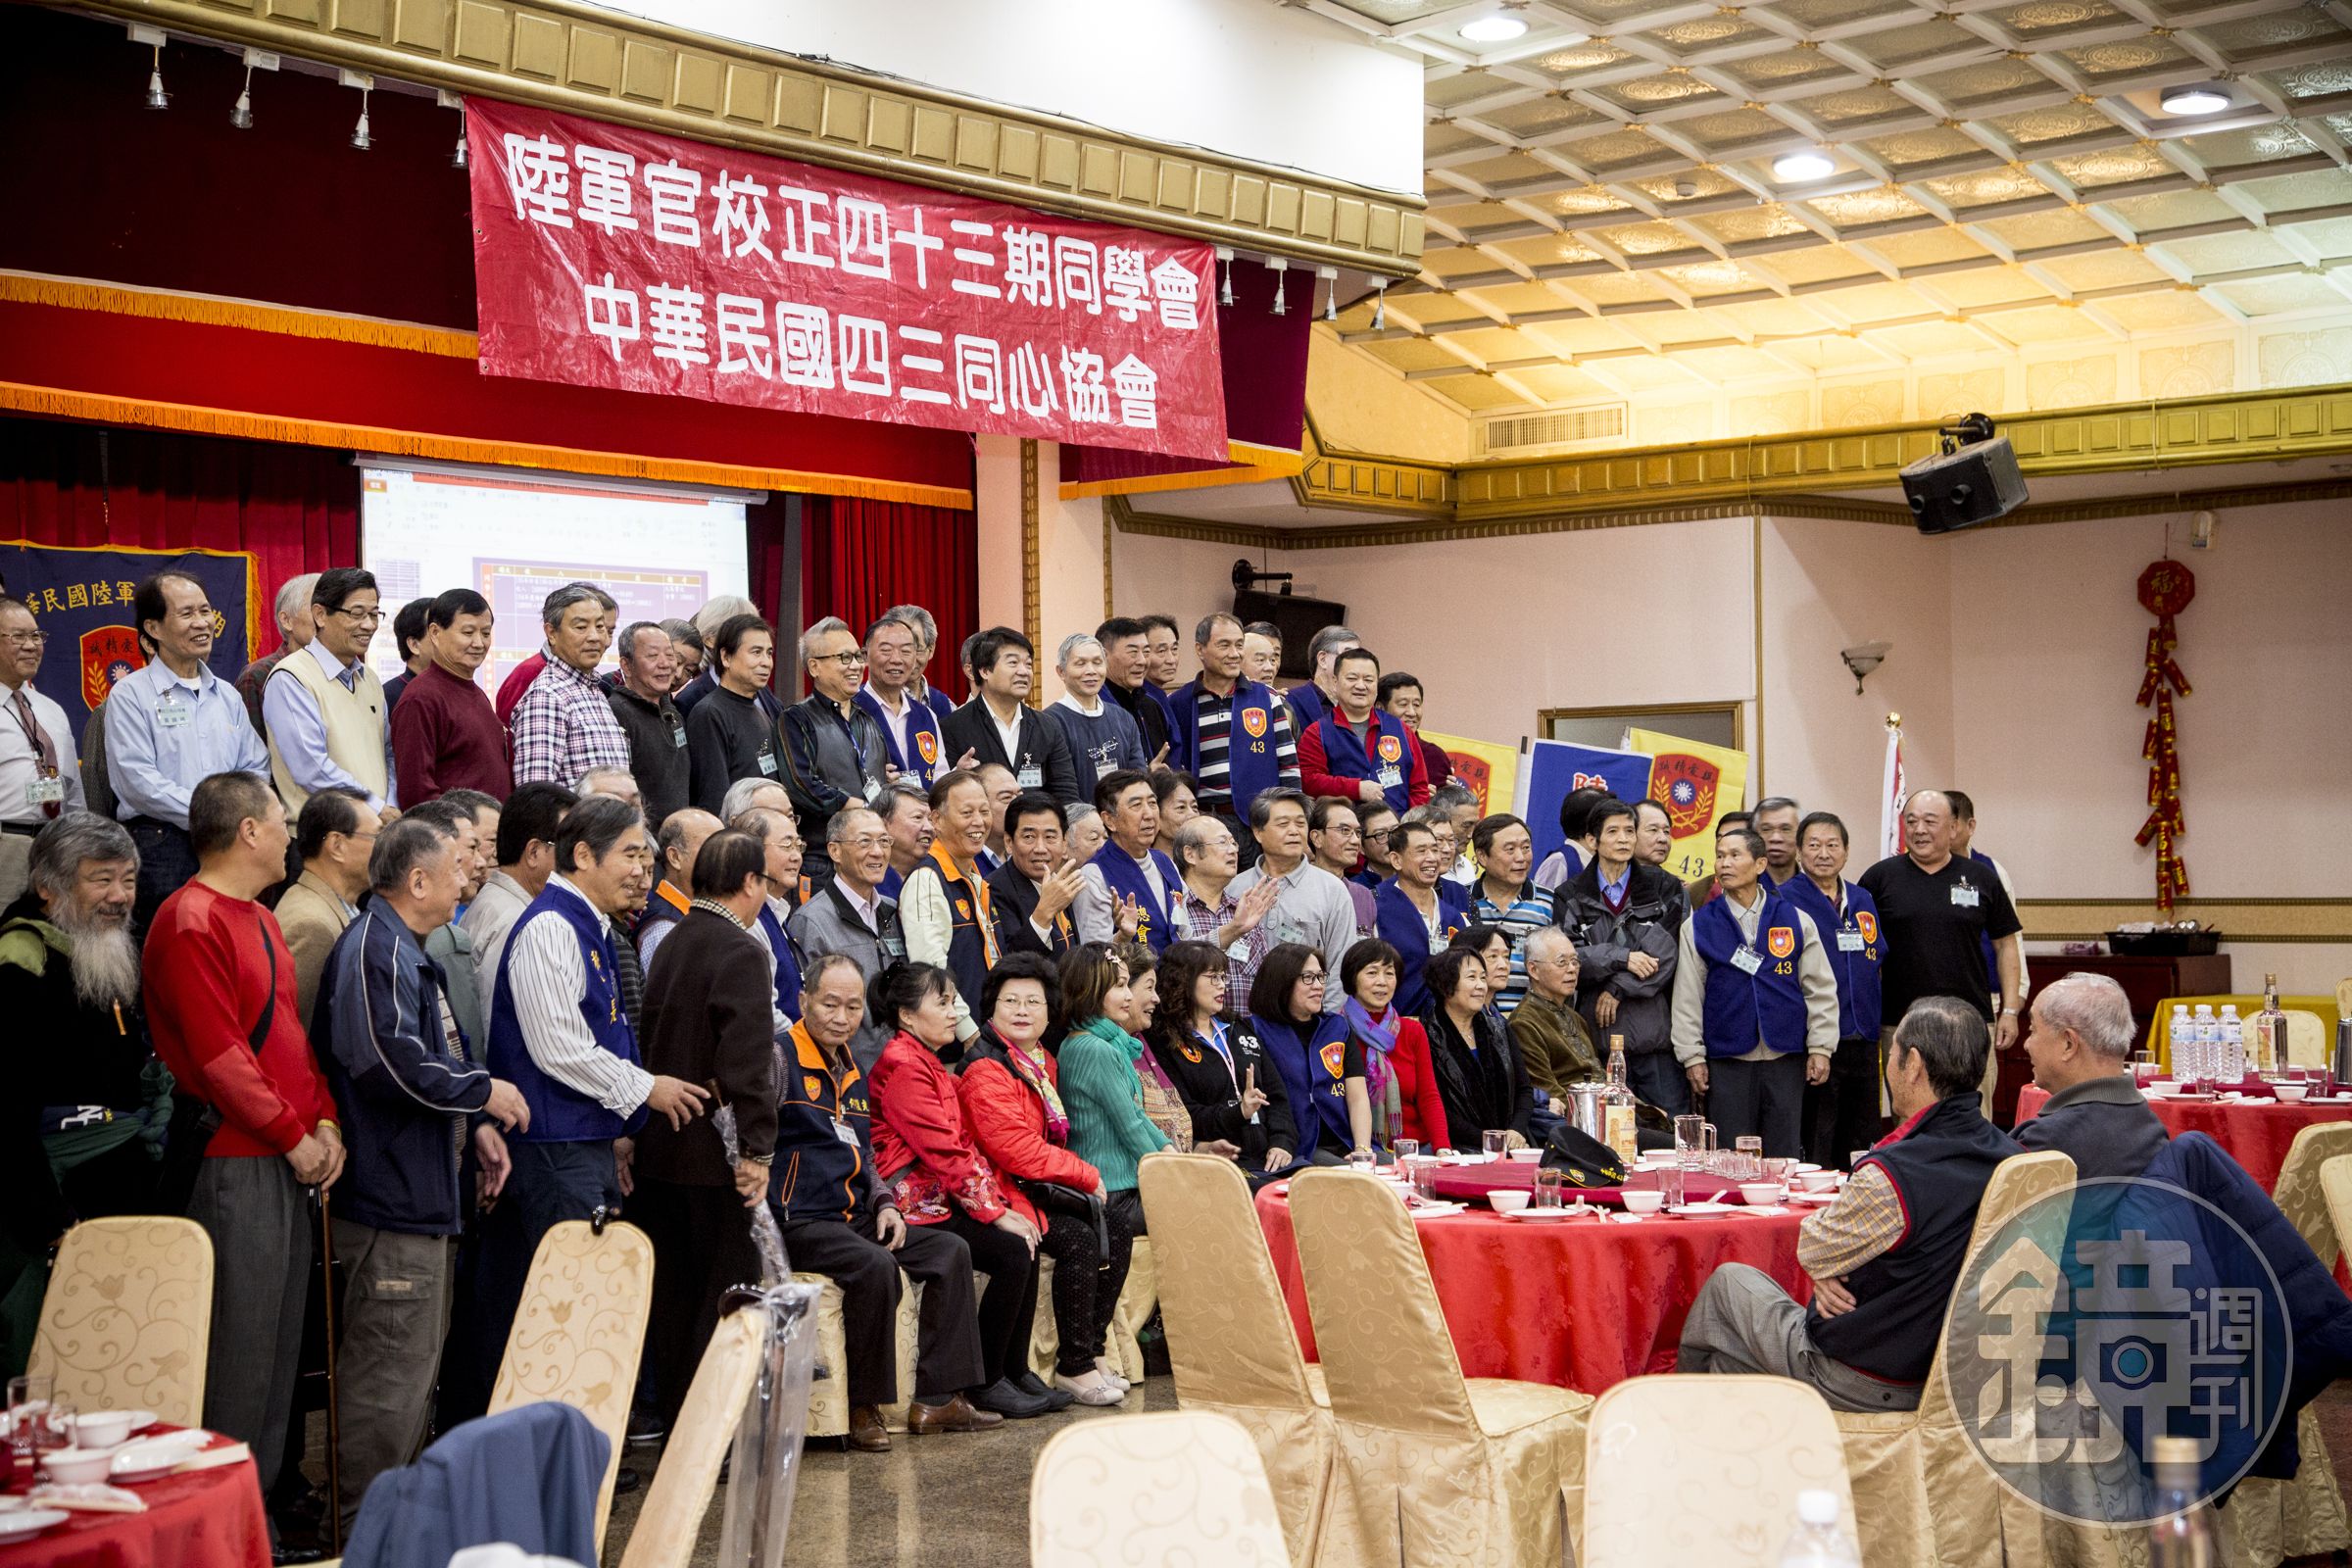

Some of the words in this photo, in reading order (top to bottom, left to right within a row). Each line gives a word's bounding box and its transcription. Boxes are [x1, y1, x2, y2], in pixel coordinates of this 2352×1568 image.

[503, 132, 1200, 330] 陸軍官校正四十三期同學會
[583, 271, 1158, 429] 中華民國四三同心協會
[1250, 741, 1265, 754] 43
[1679, 855, 1704, 878] 43
[1865, 947, 1877, 960] 43
[1774, 960, 1793, 975] 43
[1238, 1035, 1259, 1049] 43
[1331, 1082, 1346, 1097] 43
